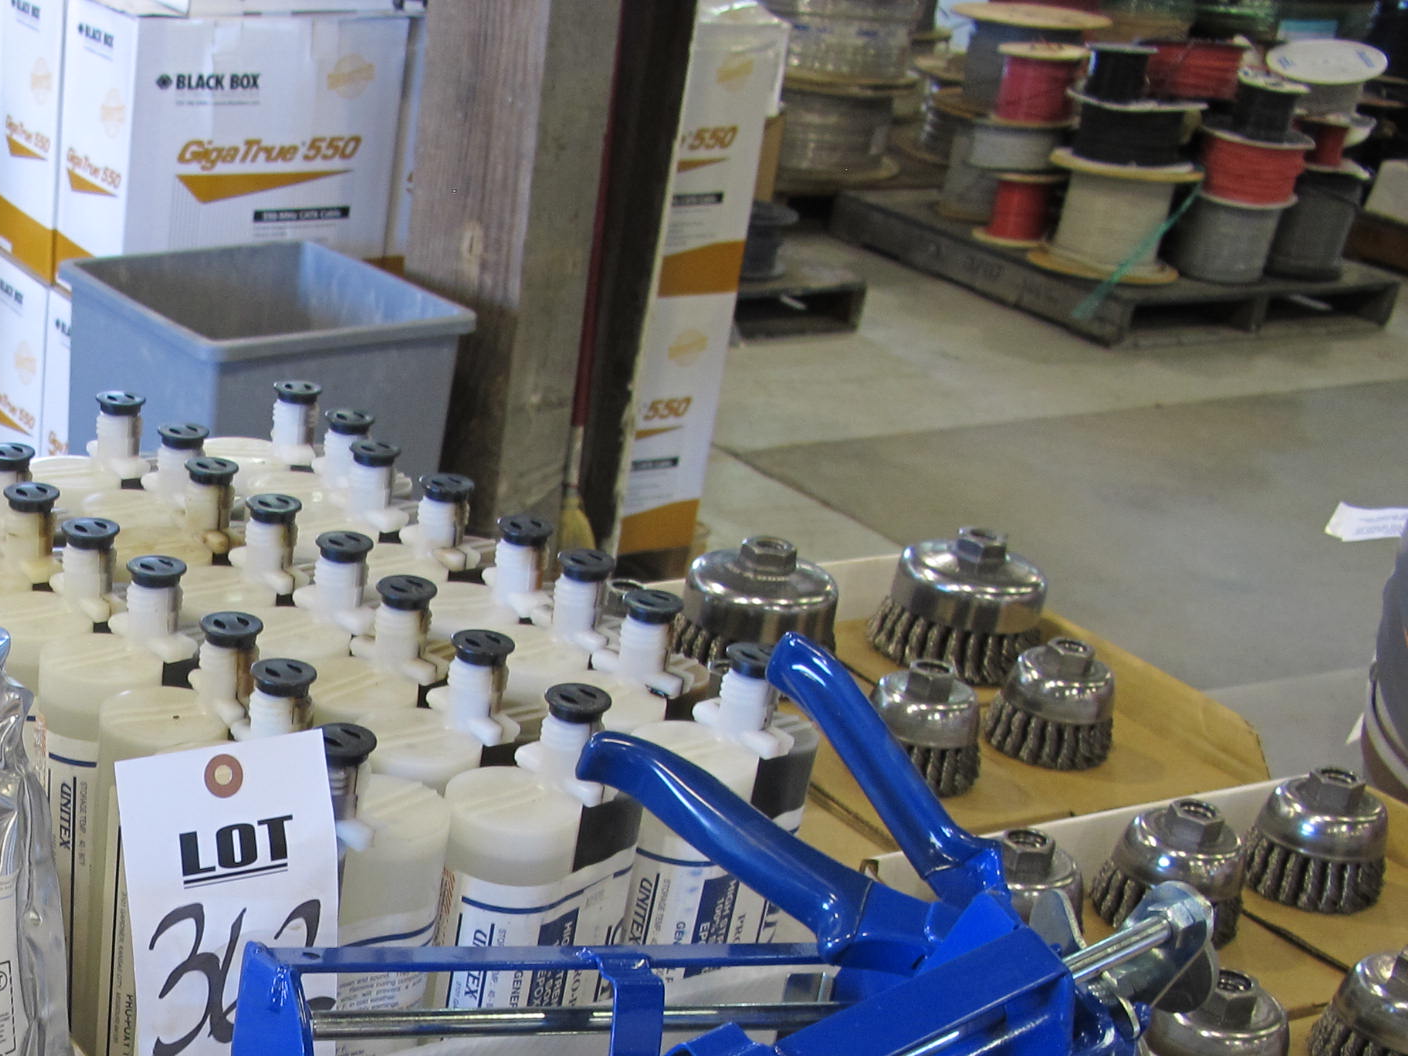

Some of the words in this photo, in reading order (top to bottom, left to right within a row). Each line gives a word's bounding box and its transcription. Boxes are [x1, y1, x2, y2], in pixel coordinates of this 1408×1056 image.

[176, 73, 224, 90] BLACK
[230, 72, 261, 89] BOX
[177, 138, 300, 171] GigaTrue
[302, 136, 362, 163] 550
[689, 124, 739, 150] 550
[643, 396, 692, 421] 550
[59, 781, 73, 851] UNITEX
[179, 815, 293, 877] LOT
[627, 876, 653, 946] UNITEX
